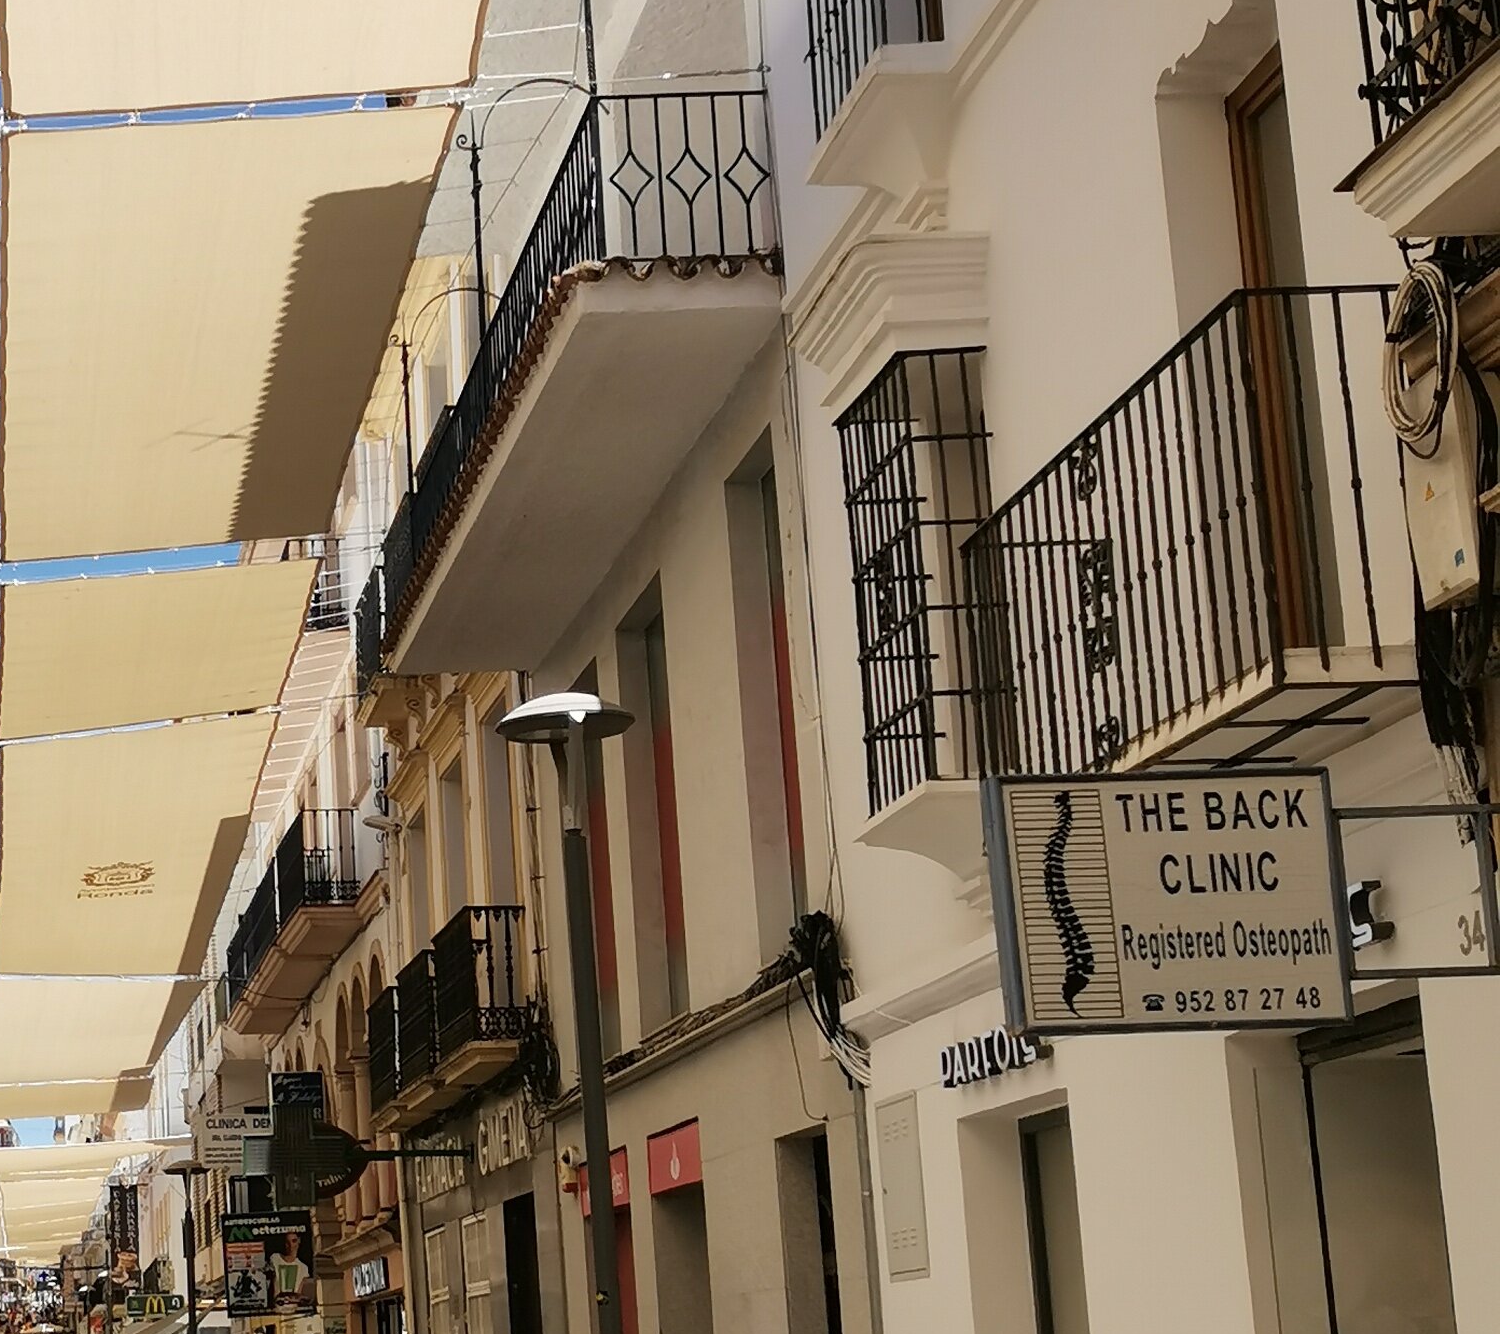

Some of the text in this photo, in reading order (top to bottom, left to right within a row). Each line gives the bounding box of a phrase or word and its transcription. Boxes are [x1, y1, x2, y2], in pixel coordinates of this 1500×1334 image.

[1115, 789, 1309, 832] THE BACK
[1159, 851, 1279, 894] CLINIC
[1121, 918, 1332, 970] Registered Osteopath
[1458, 909, 1486, 957] 34
[1175, 986, 1321, 1013] 952 87 27 48
[940, 1025, 1037, 1088] PARFOIS
[205, 1118, 248, 1129] CLINICA
